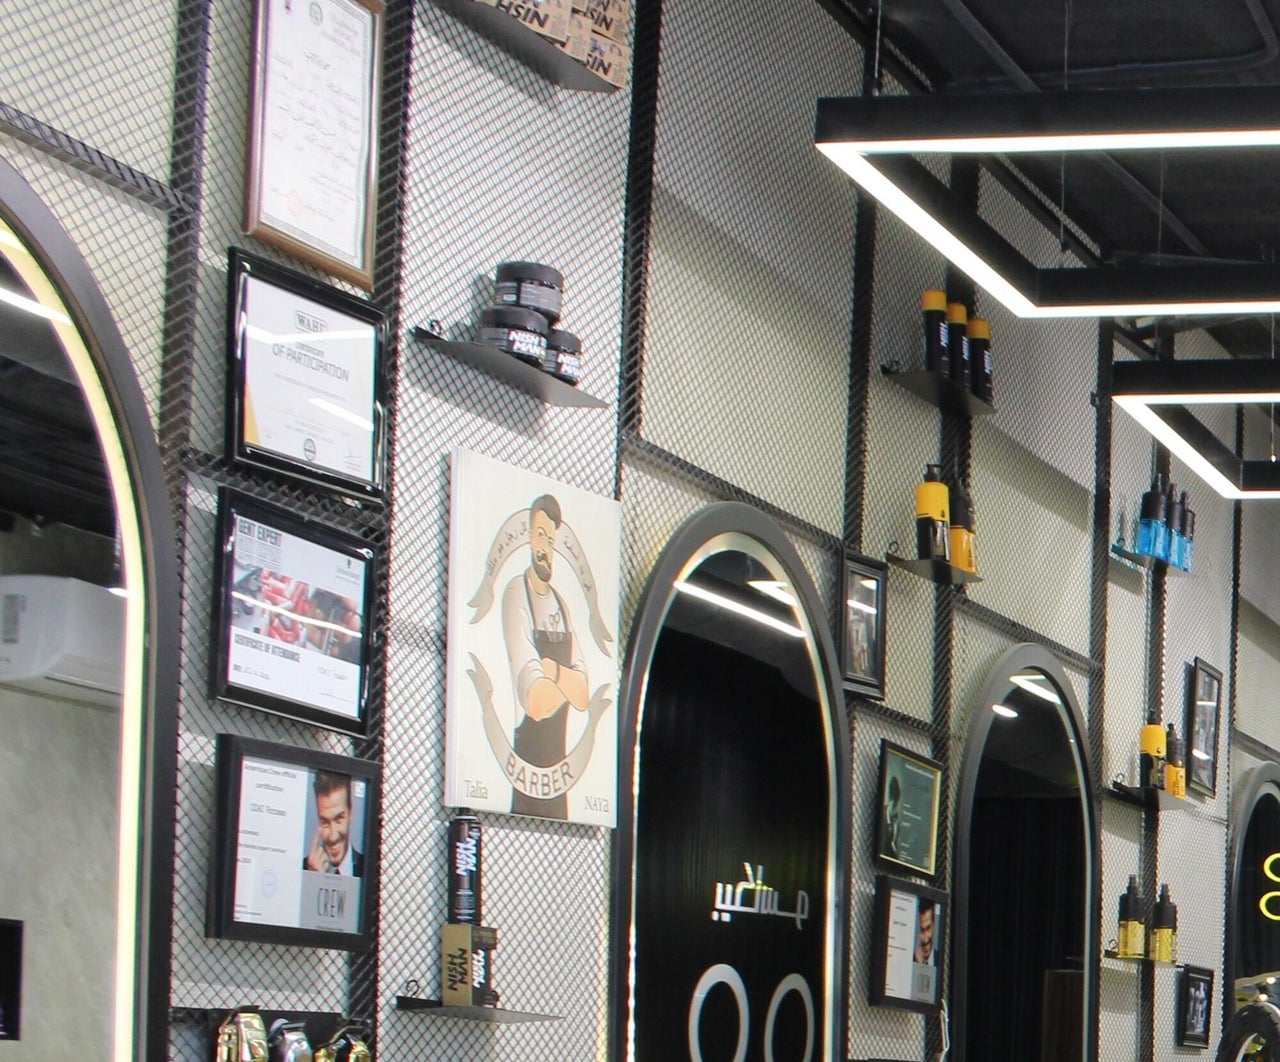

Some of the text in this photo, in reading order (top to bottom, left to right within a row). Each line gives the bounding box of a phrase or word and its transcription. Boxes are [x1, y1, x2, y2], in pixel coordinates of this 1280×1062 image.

[272, 343, 350, 382] OF PARTICIPATION
[505, 752, 574, 796] BARBER
[456, 841, 467, 876] NISH
[466, 837, 477, 872] MAN
[318, 887, 347, 918] CREW
[448, 953, 459, 991] NISH
[457, 947, 468, 985] MAN
